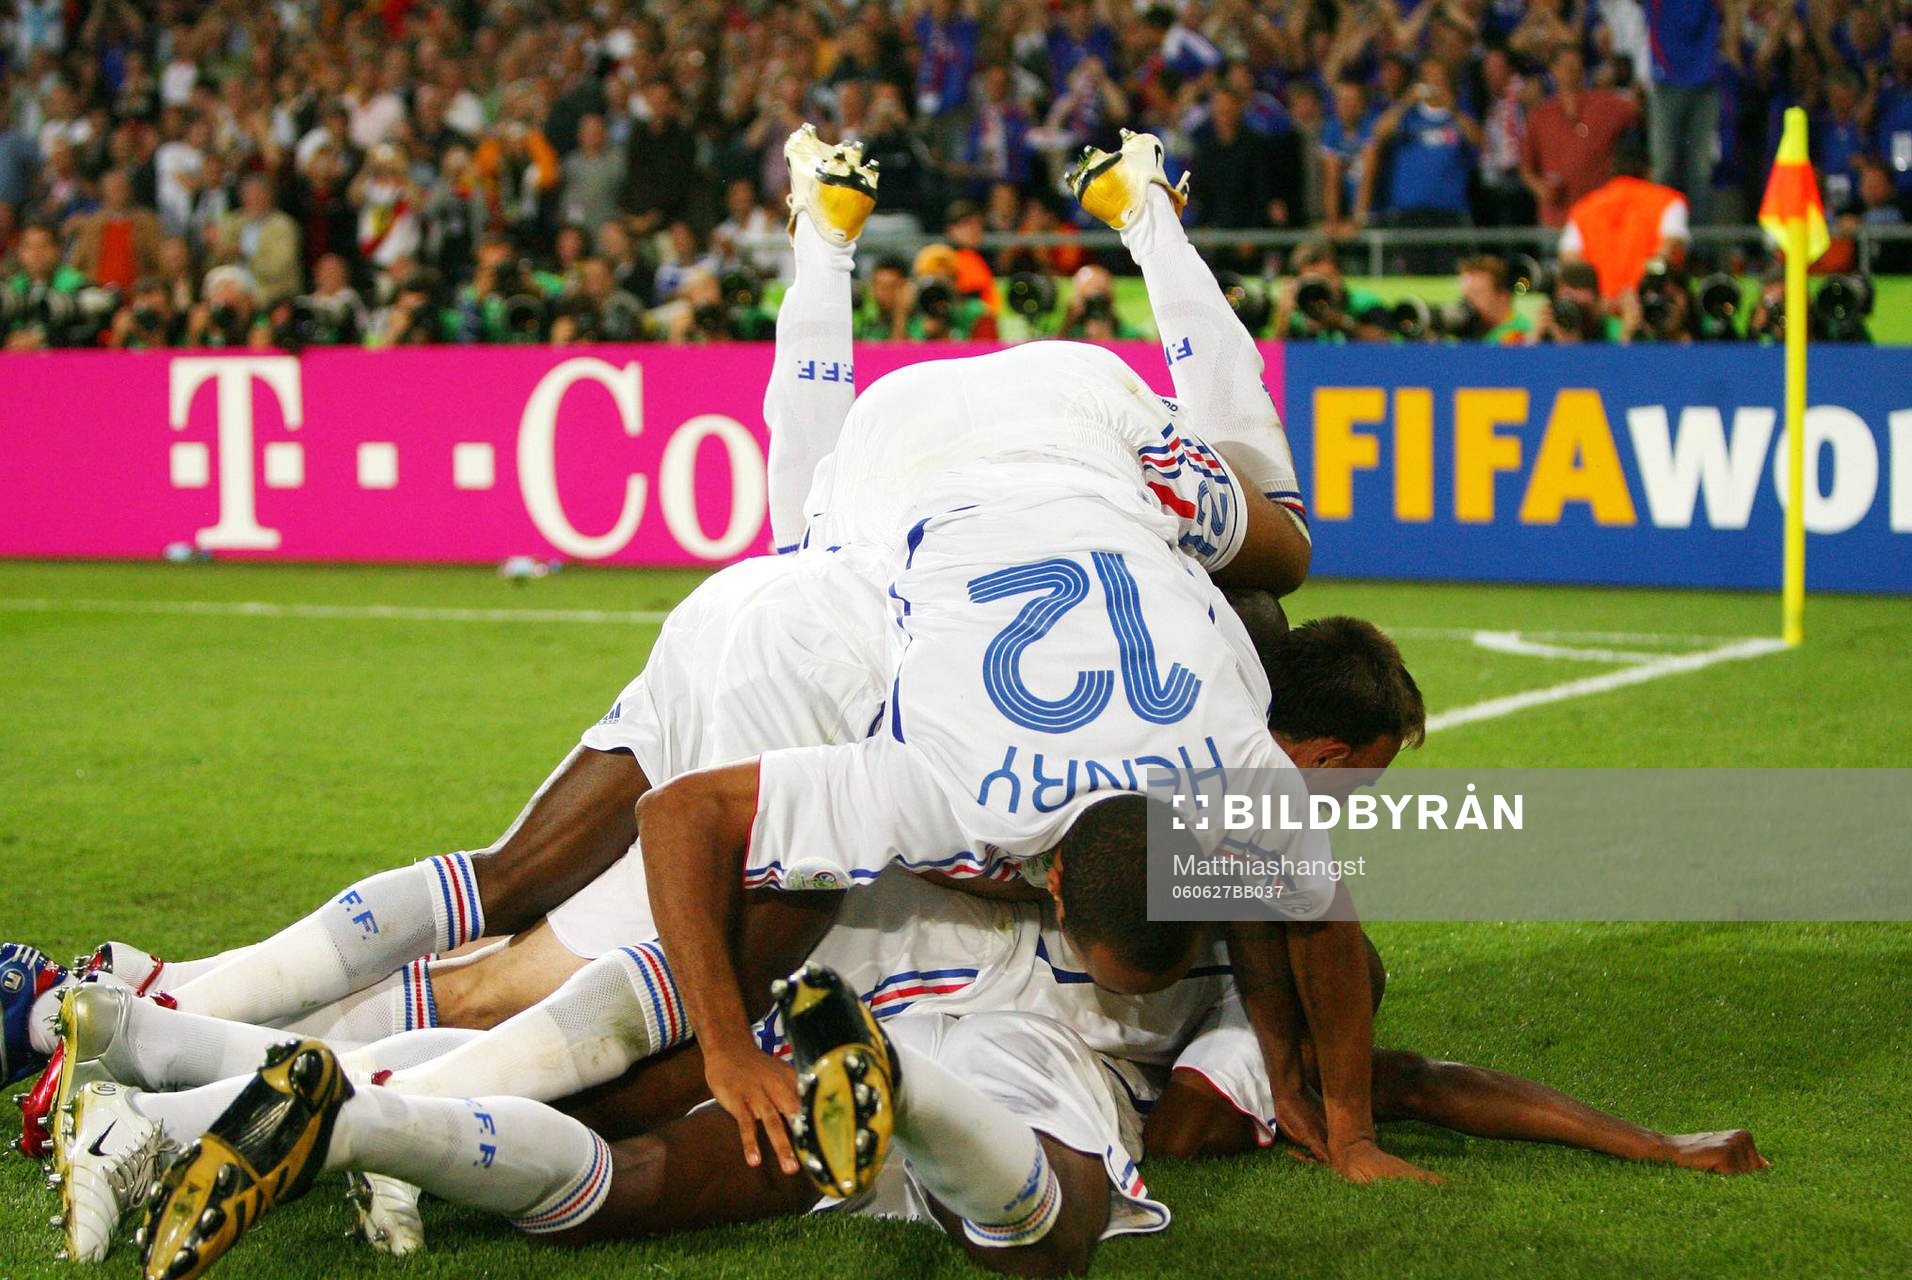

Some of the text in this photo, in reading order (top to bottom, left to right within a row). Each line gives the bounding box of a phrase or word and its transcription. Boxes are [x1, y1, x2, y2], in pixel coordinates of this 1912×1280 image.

[517, 357, 774, 560] Co
[967, 551, 1202, 734] 12
[977, 737, 1227, 814] HENRY
